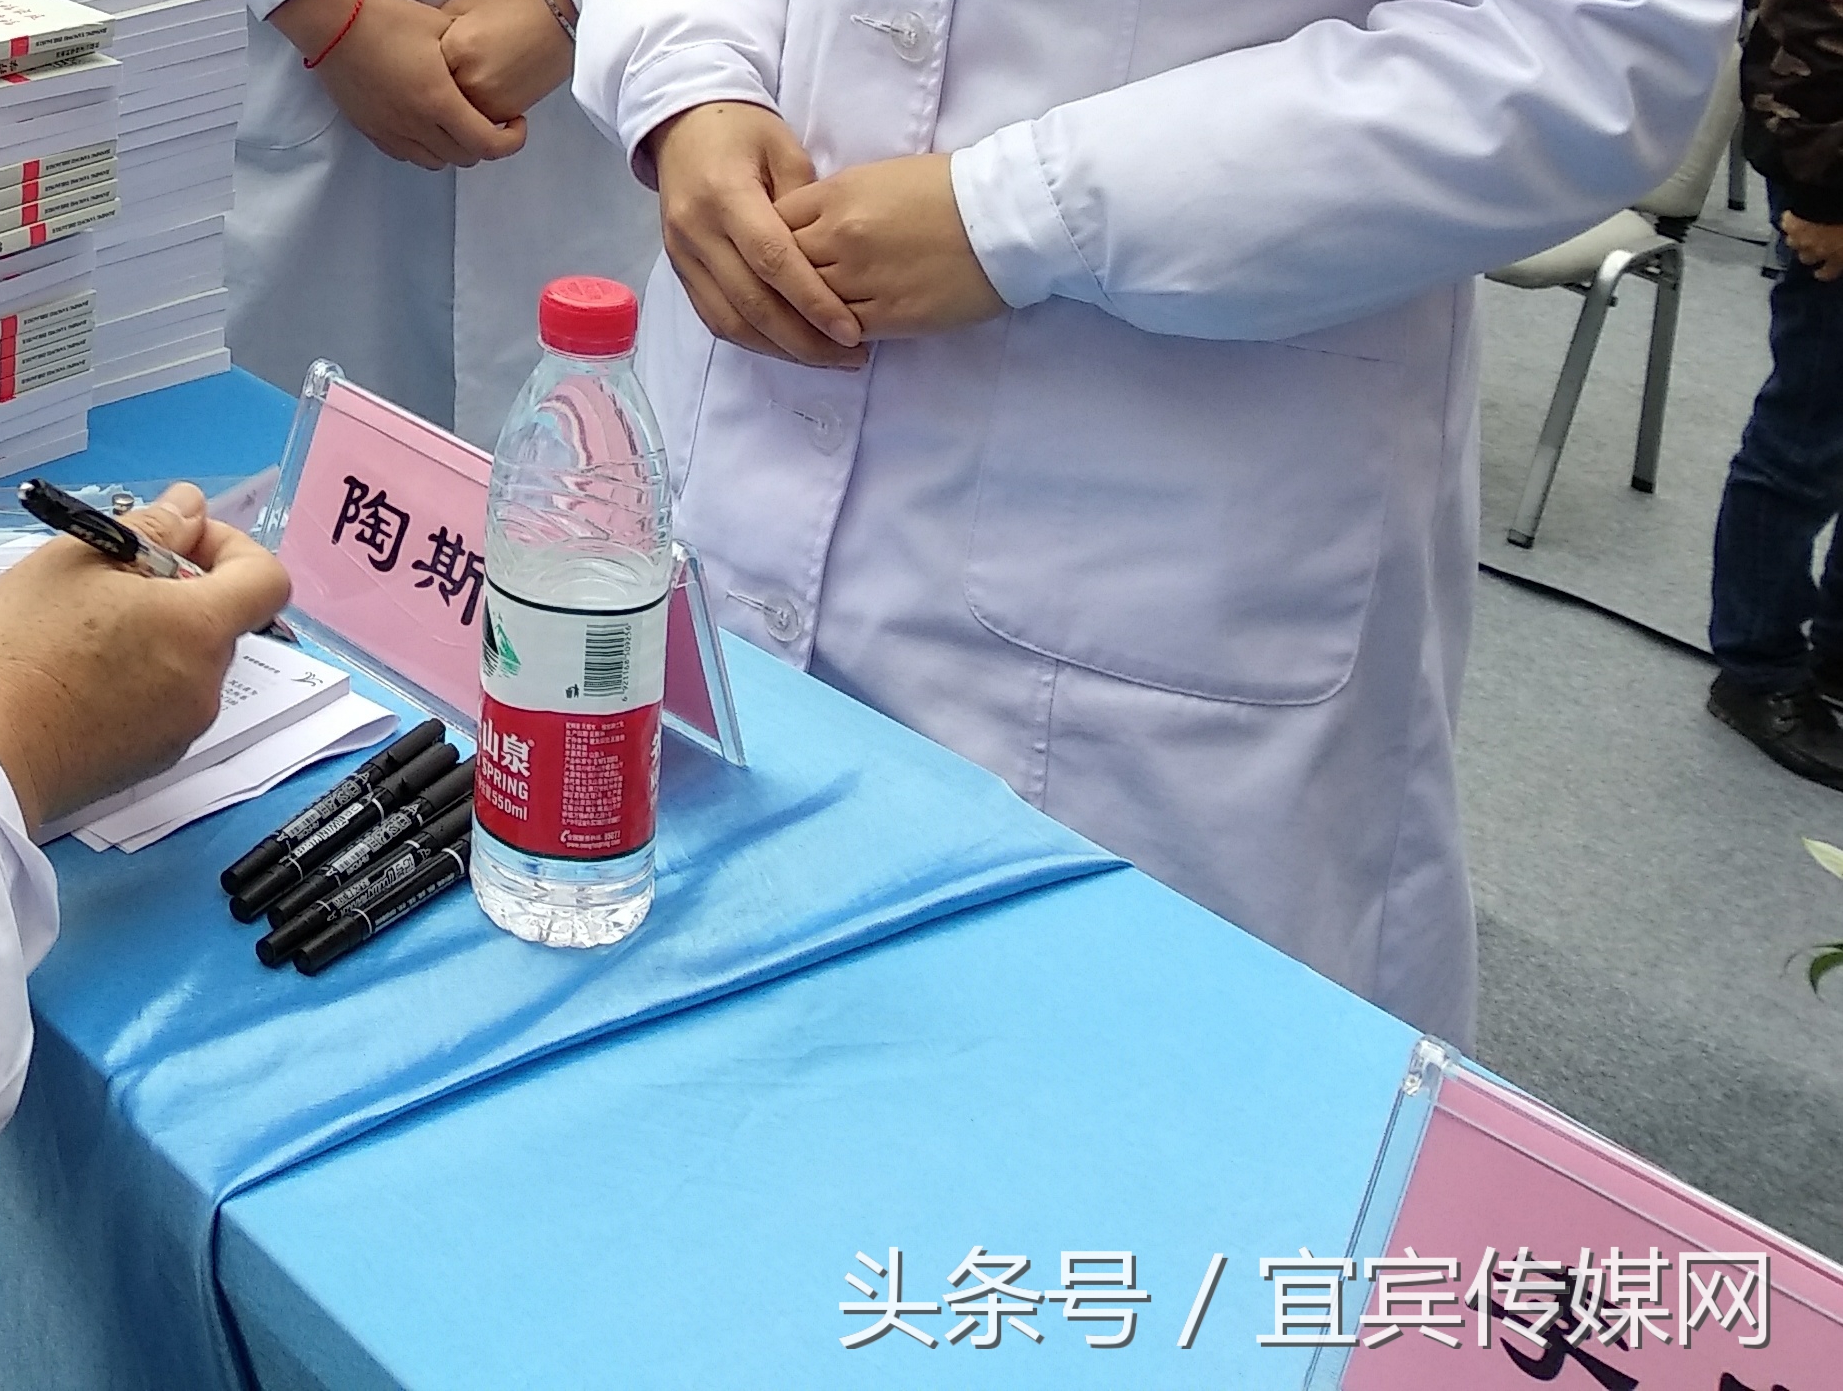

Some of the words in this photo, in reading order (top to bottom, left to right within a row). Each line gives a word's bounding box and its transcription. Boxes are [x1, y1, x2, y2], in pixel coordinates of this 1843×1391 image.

[331, 475, 485, 626] 陶斯
[482, 718, 531, 778] 山泉
[481, 756, 529, 802] SPRING
